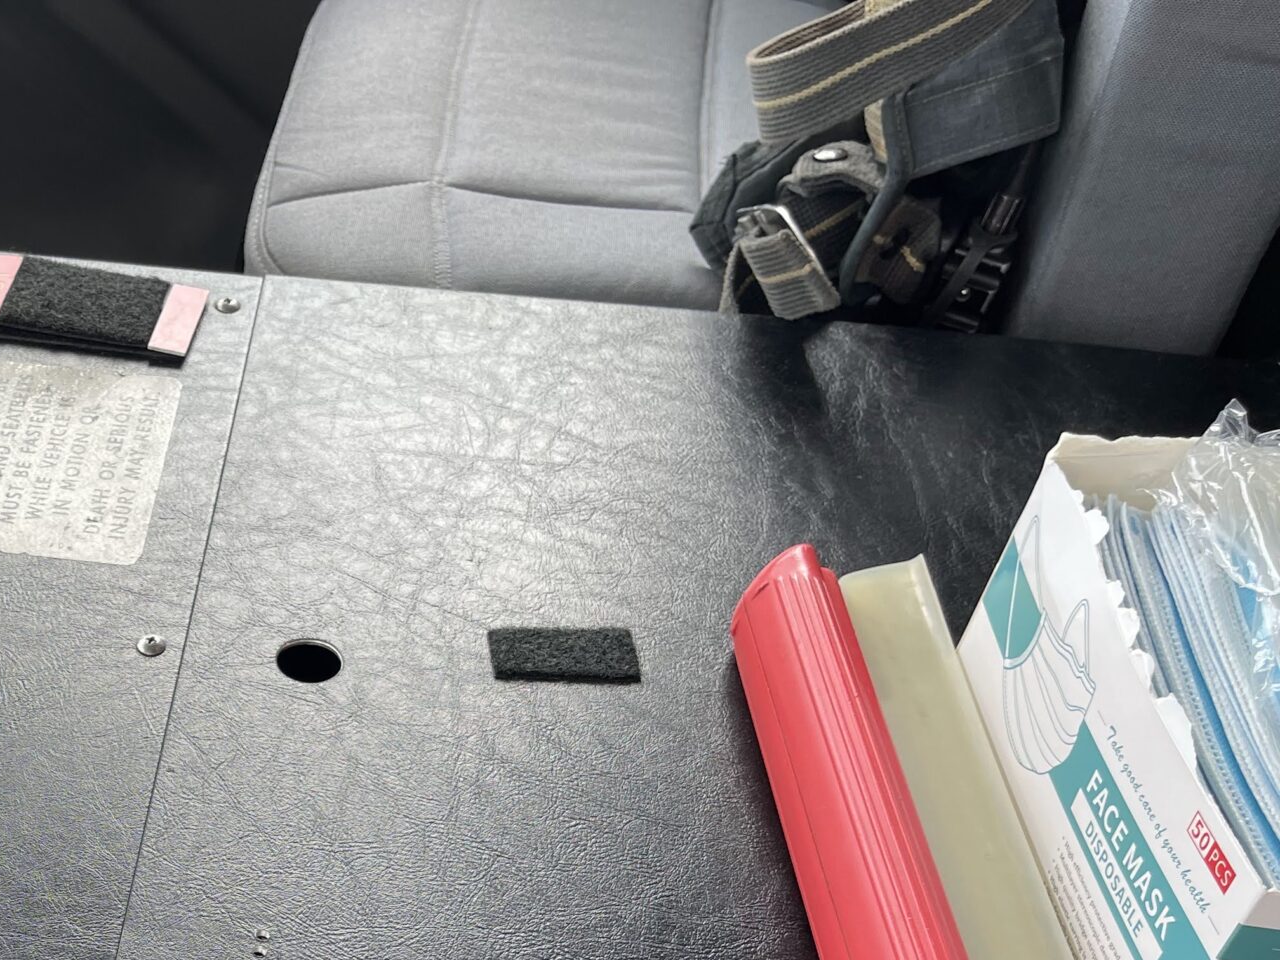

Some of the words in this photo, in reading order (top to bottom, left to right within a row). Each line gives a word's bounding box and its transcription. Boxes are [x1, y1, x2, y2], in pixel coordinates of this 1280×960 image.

[0, 373, 35, 438] SEATBELTS
[24, 475, 53, 521] WHILE
[40, 419, 69, 471] VEHICLE
[59, 392, 75, 409] IS
[13, 458, 34, 479] BE
[51, 497, 71, 517] IN
[62, 432, 90, 492] MOTION
[83, 486, 112, 536] DEATH
[98, 460, 117, 482] OR
[109, 395, 134, 452] SERIOUS
[108, 486, 136, 540] INJURY
[123, 446, 146, 482] MAY
[1086, 768, 1130, 852] FACE
[1122, 843, 1176, 941] MASK
[1104, 725, 1124, 762] Take
[1120, 763, 1144, 793] good
[1139, 795, 1156, 822] care
[1154, 821, 1168, 840] of
[1163, 839, 1182, 869] your
[1180, 868, 1211, 914] health
[1190, 819, 1211, 851] 50
[1207, 851, 1233, 888] PCS
[1085, 820, 1144, 939] DISPOSABLE
